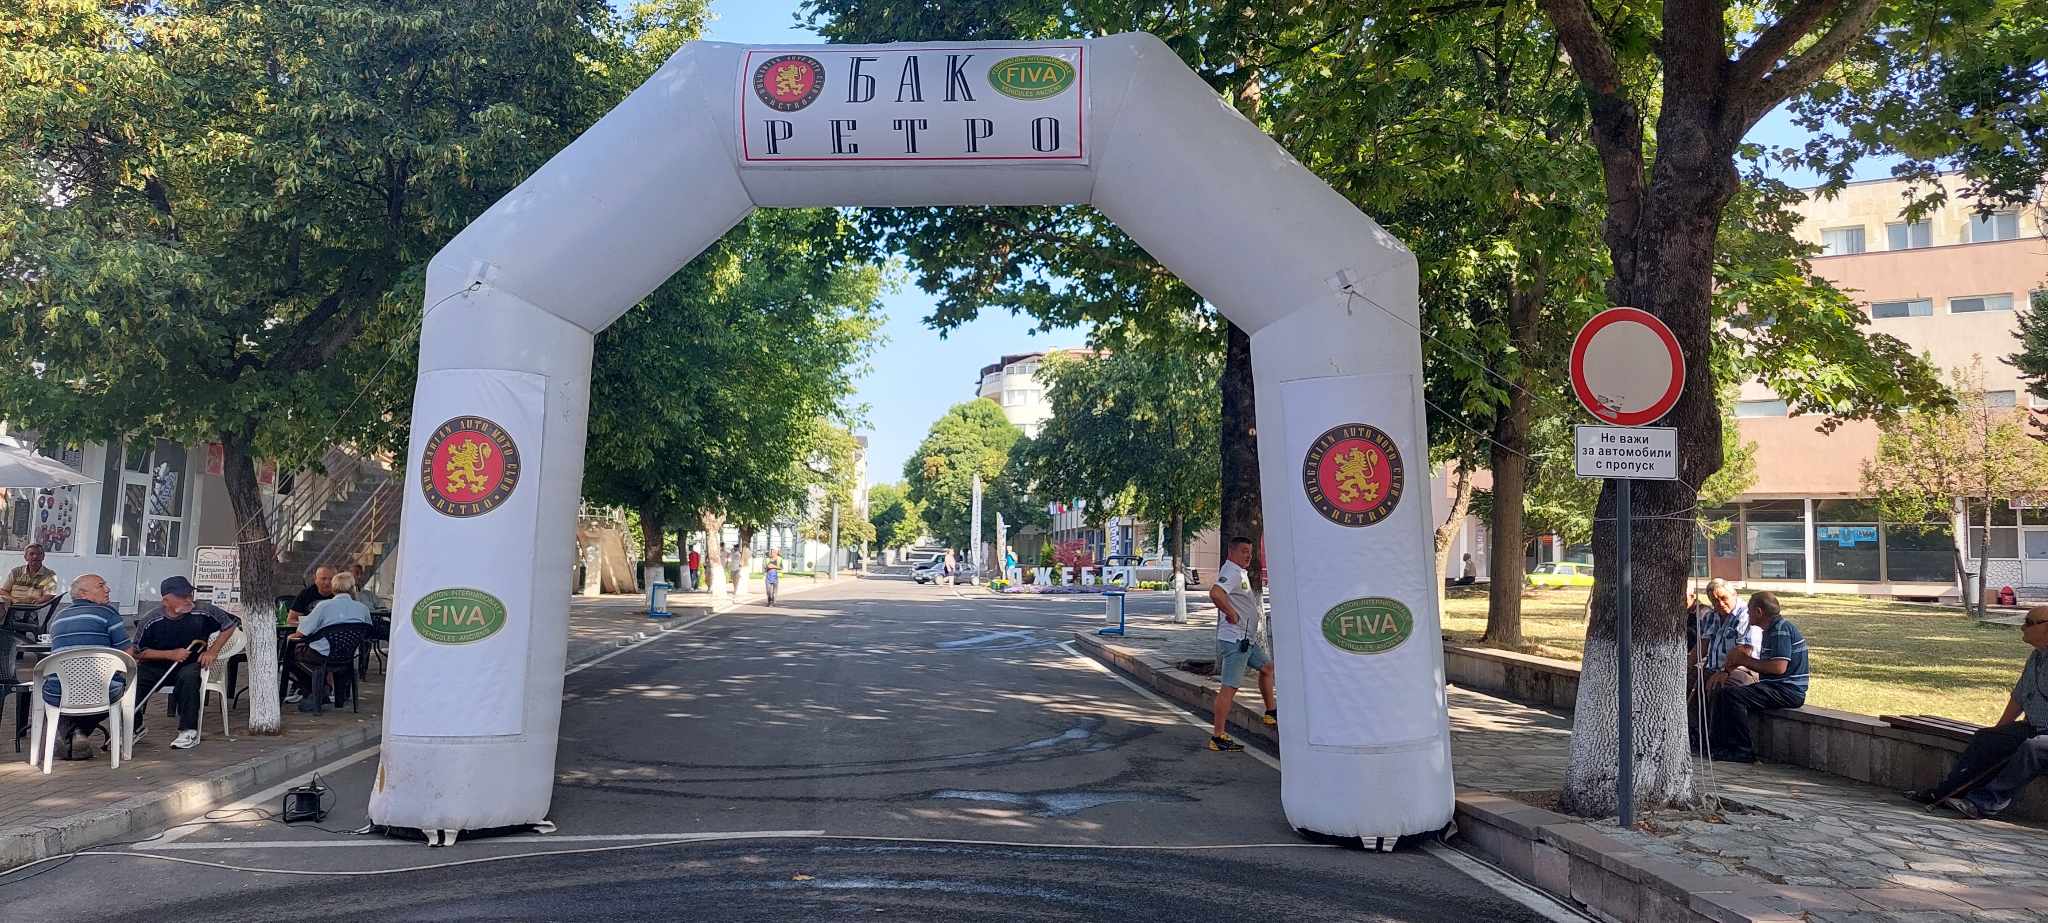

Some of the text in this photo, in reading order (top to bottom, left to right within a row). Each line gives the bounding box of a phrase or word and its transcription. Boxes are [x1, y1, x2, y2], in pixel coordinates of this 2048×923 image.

[846, 54, 977, 104] БАК
[1006, 67, 1058, 83] FIVA
[764, 116, 1060, 155] РЕТРО
[1343, 427, 1372, 438] AUTO
[1601, 433, 1649, 445] Не важи
[1582, 447, 1672, 458] за автомобили
[1596, 461, 1655, 472] с пропуск
[1331, 505, 1387, 524] RETRO
[427, 605, 486, 625] FIVA
[1340, 613, 1398, 636] FIVA
